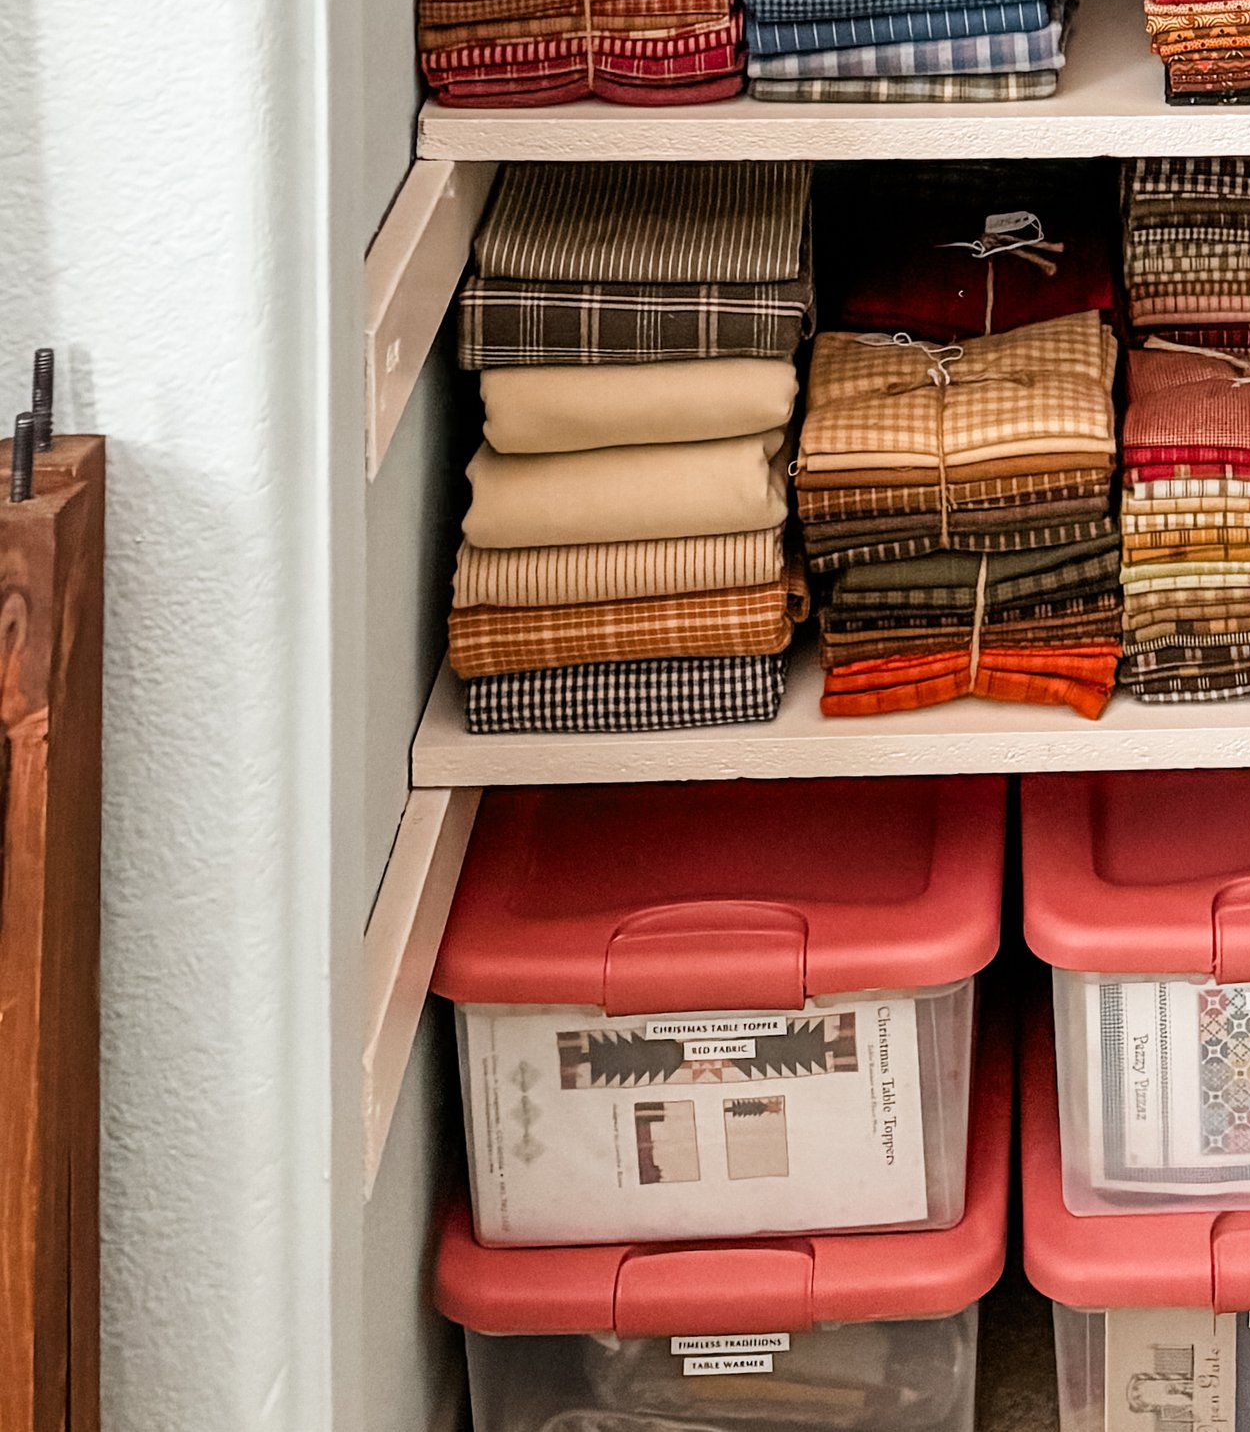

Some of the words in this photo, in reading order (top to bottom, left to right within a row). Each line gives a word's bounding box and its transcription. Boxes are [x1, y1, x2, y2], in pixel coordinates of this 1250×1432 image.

[652, 1025, 708, 1034] CHRISTMAS
[711, 1023, 738, 1032] TABLE
[743, 1021, 778, 1030] TOPPER
[877, 1005, 891, 1075] Christmas
[691, 1047, 710, 1055] RED
[713, 1044, 747, 1053] FABRIC
[882, 1077, 896, 1113] Table
[882, 1116, 897, 1166] Toppers
[678, 1340, 721, 1350] TIMELESS
[725, 1338, 782, 1348] TRADITIONS
[692, 1362, 720, 1370] TABLE
[723, 1359, 764, 1369] WARMER
